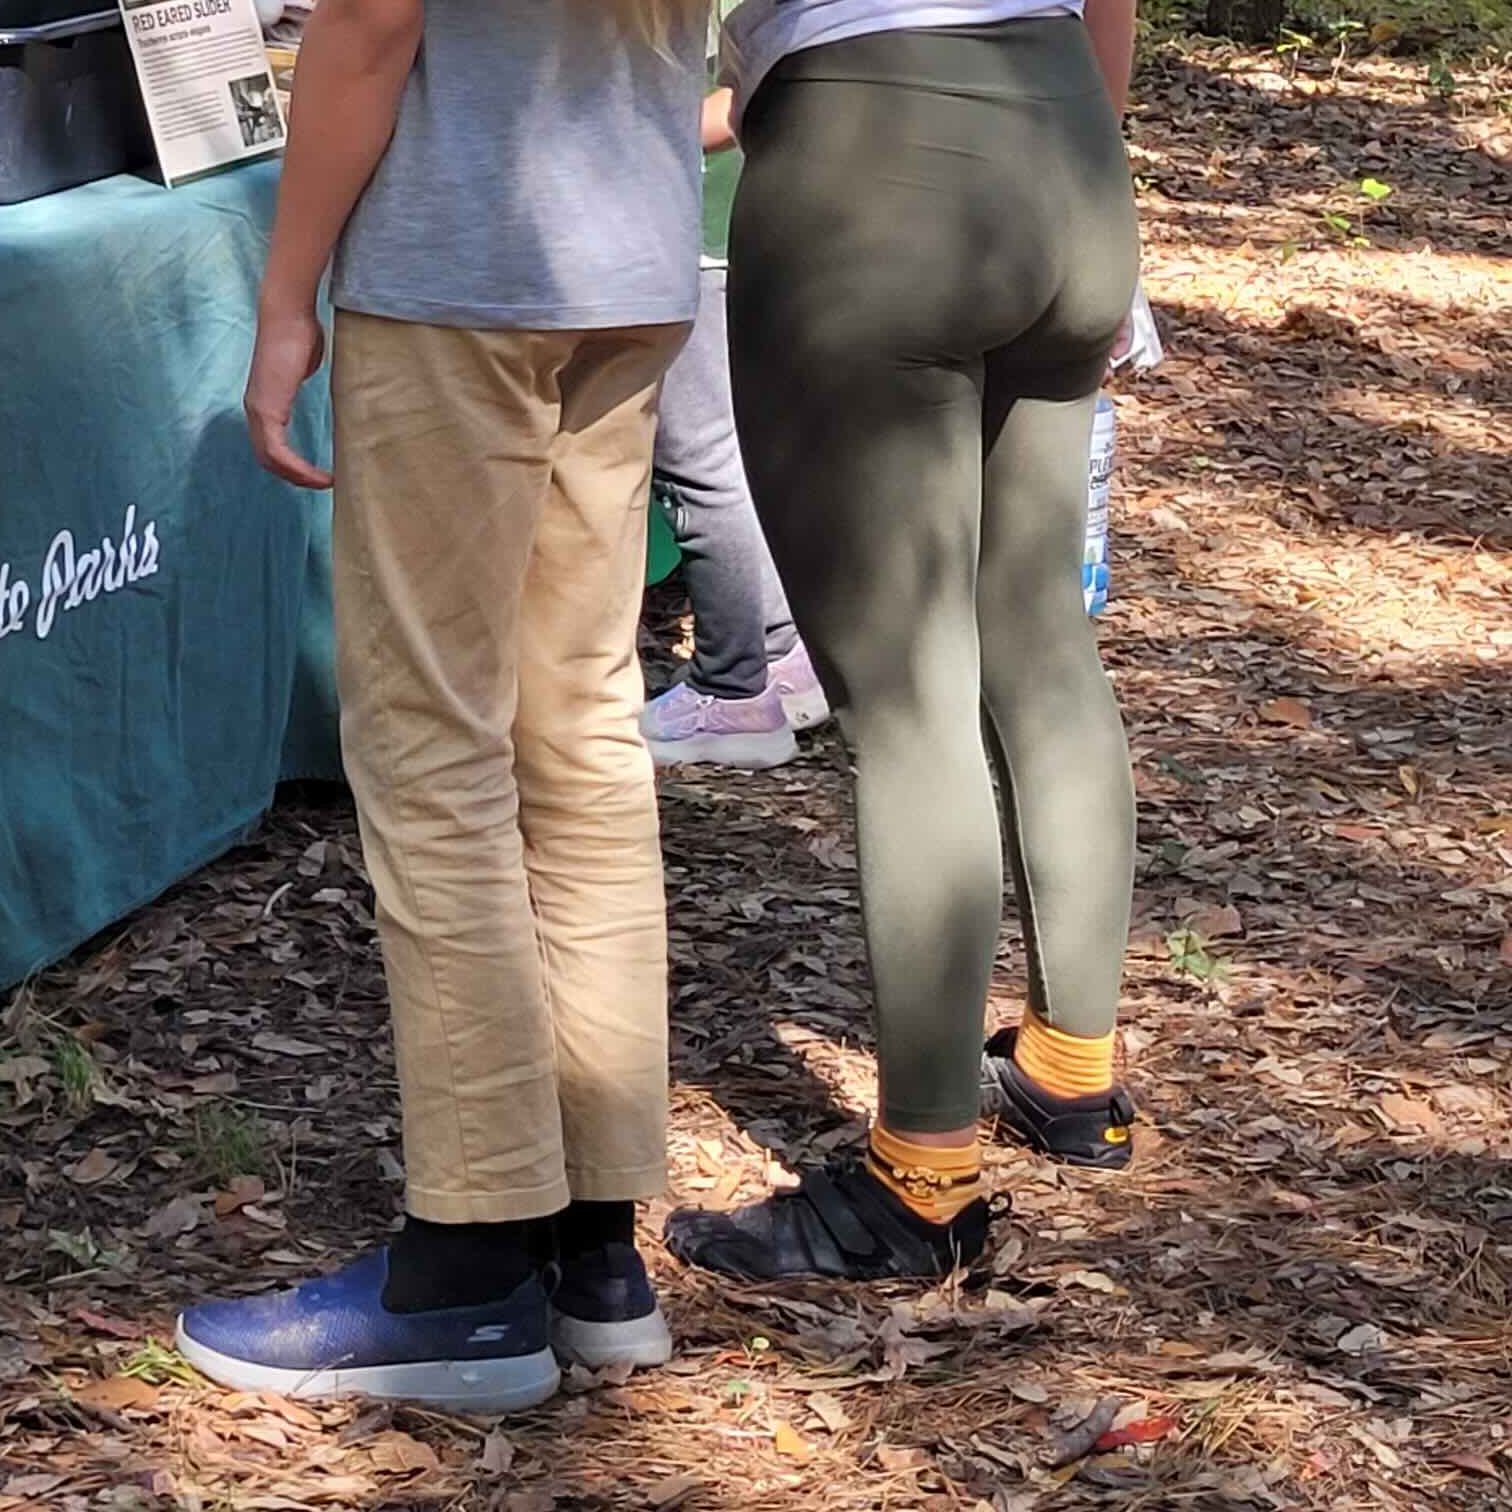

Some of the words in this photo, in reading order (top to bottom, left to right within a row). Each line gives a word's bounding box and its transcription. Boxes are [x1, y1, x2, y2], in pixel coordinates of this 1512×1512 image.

[132, 11, 155, 33] RED
[158, 2, 192, 27] EARED
[35, 504, 161, 639] Parks
